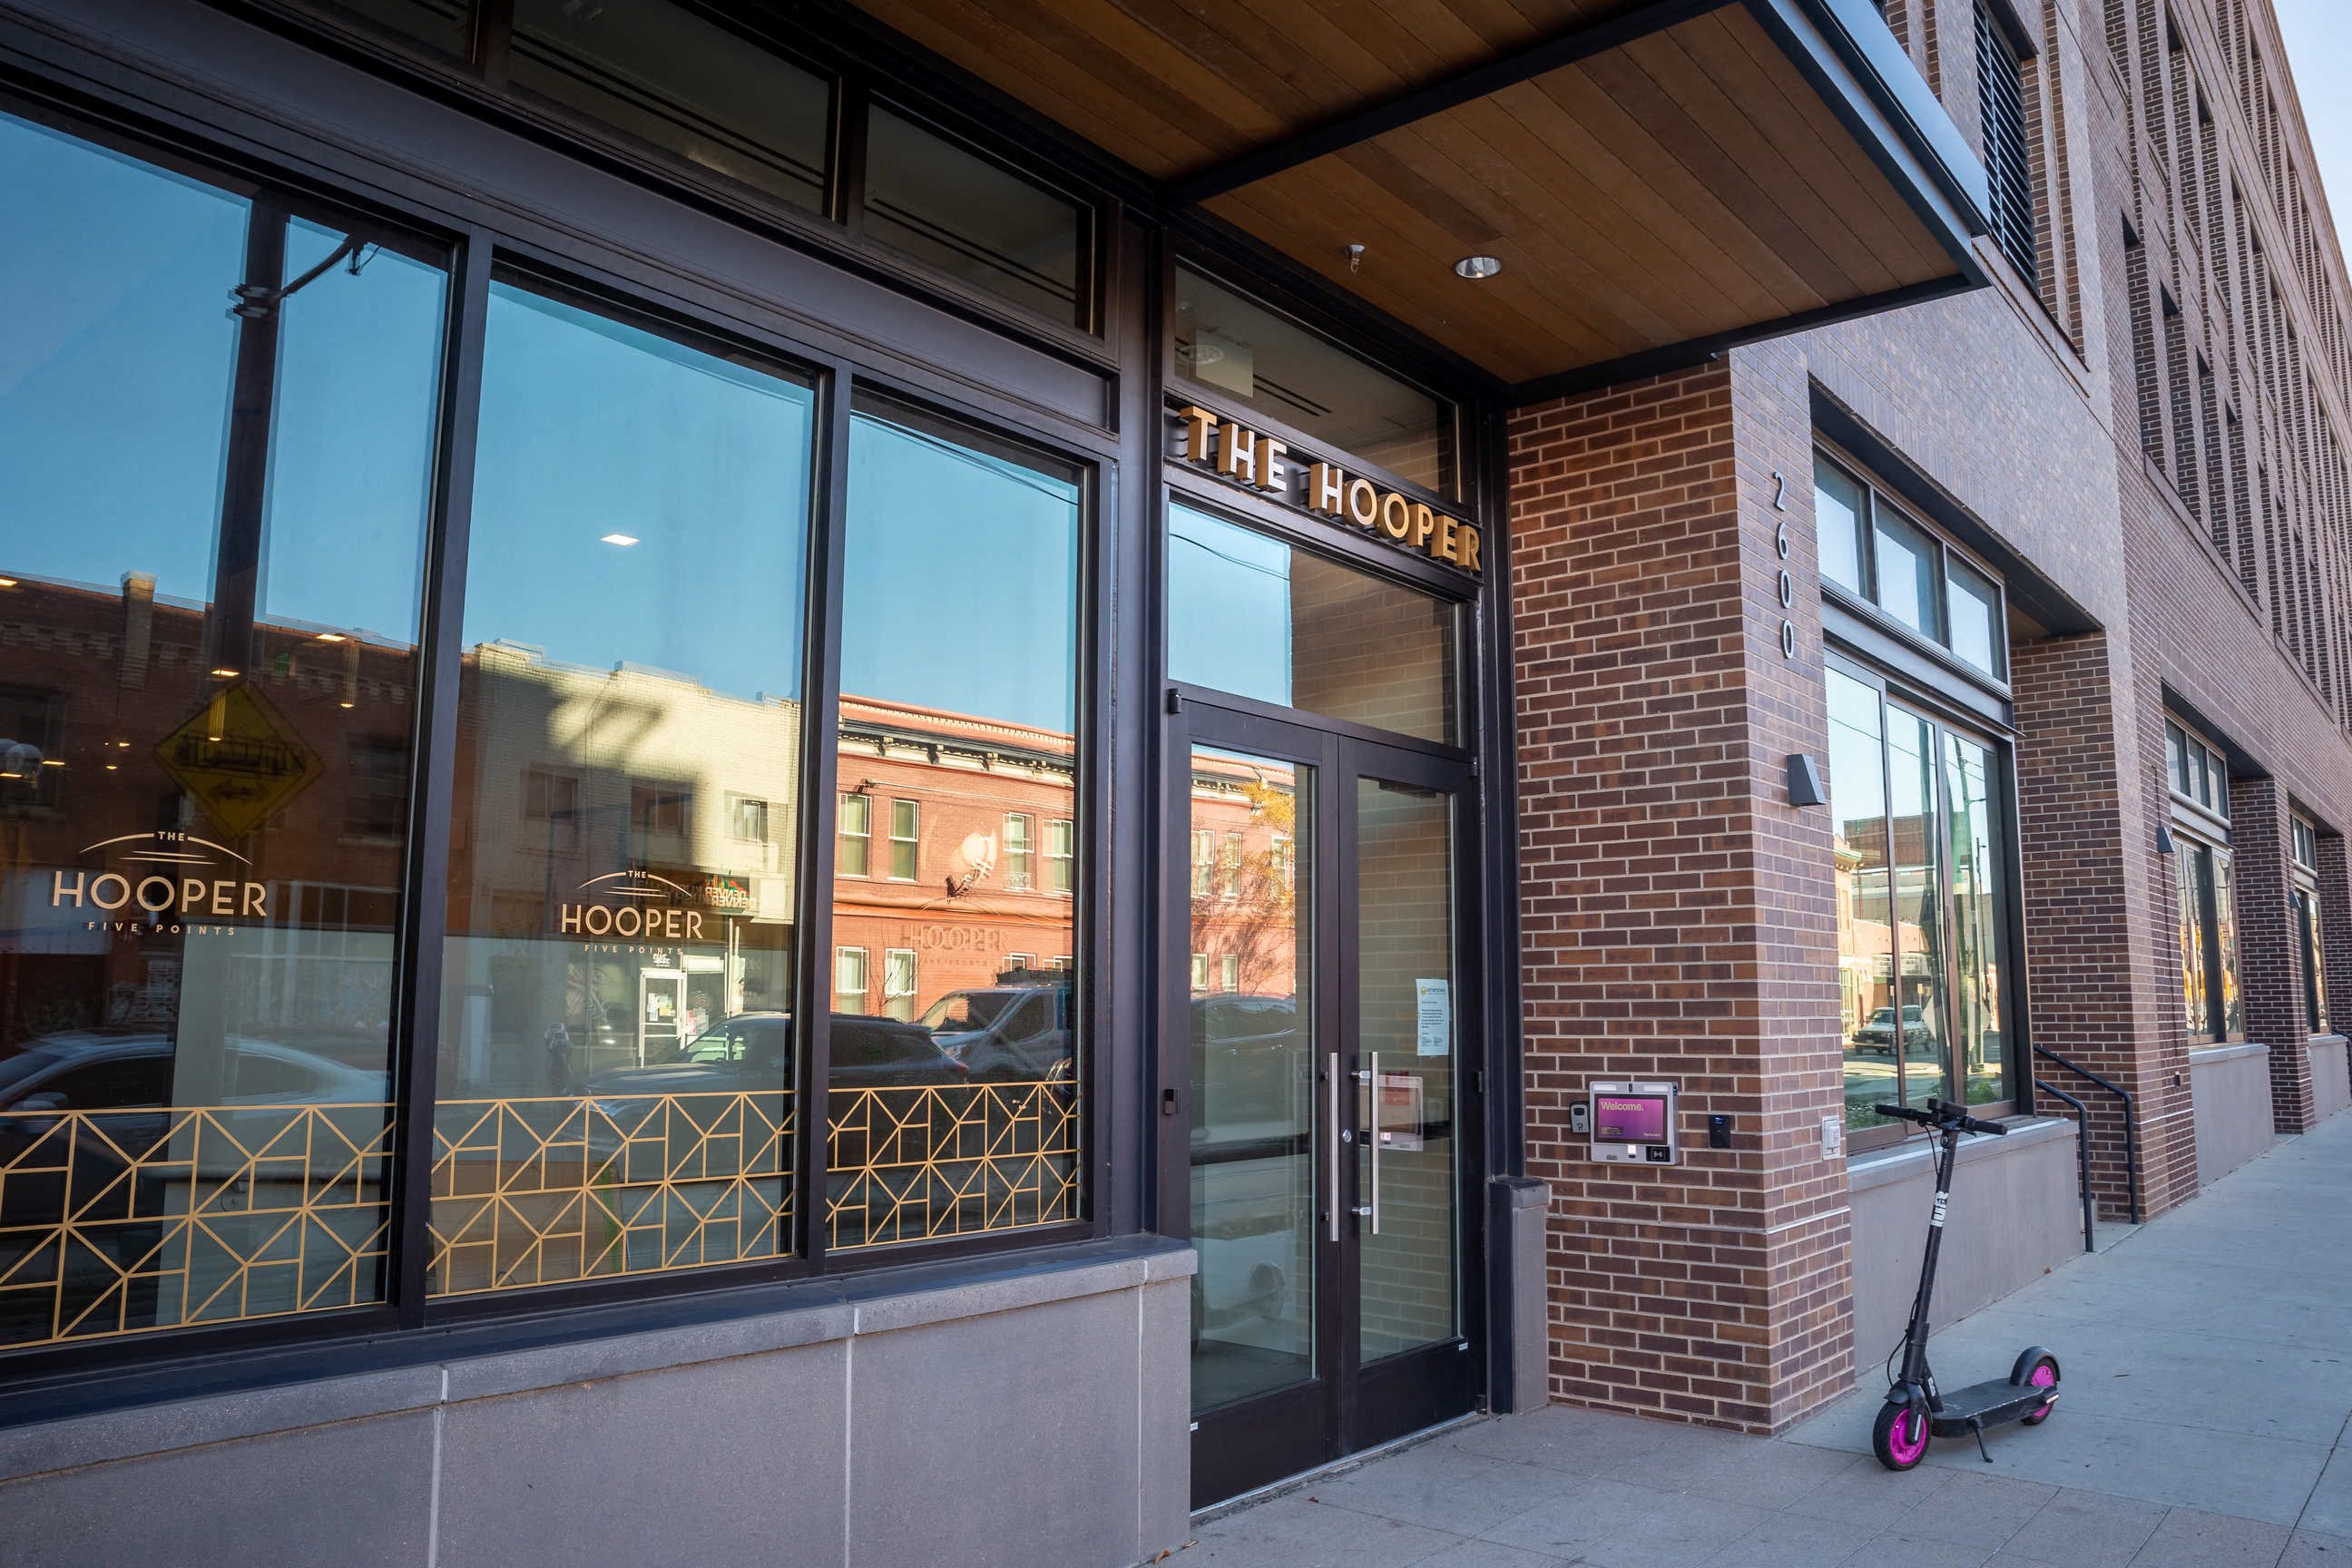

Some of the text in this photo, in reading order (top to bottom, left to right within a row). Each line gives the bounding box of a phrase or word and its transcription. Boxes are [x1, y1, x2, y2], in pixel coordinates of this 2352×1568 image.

[1180, 406, 1482, 571] THE HOOPER
[1772, 471, 1795, 660] 2600
[158, 831, 185, 842] THE
[628, 870, 647, 878] THE
[53, 870, 268, 916] HOOPER
[88, 921, 235, 936] FIVE POINTS
[561, 904, 703, 939] HOOPER
[909, 924, 1009, 951] HOOPER
[584, 944, 682, 956] FIVE POINTS
[1601, 1101, 1644, 1112] Welcome.
